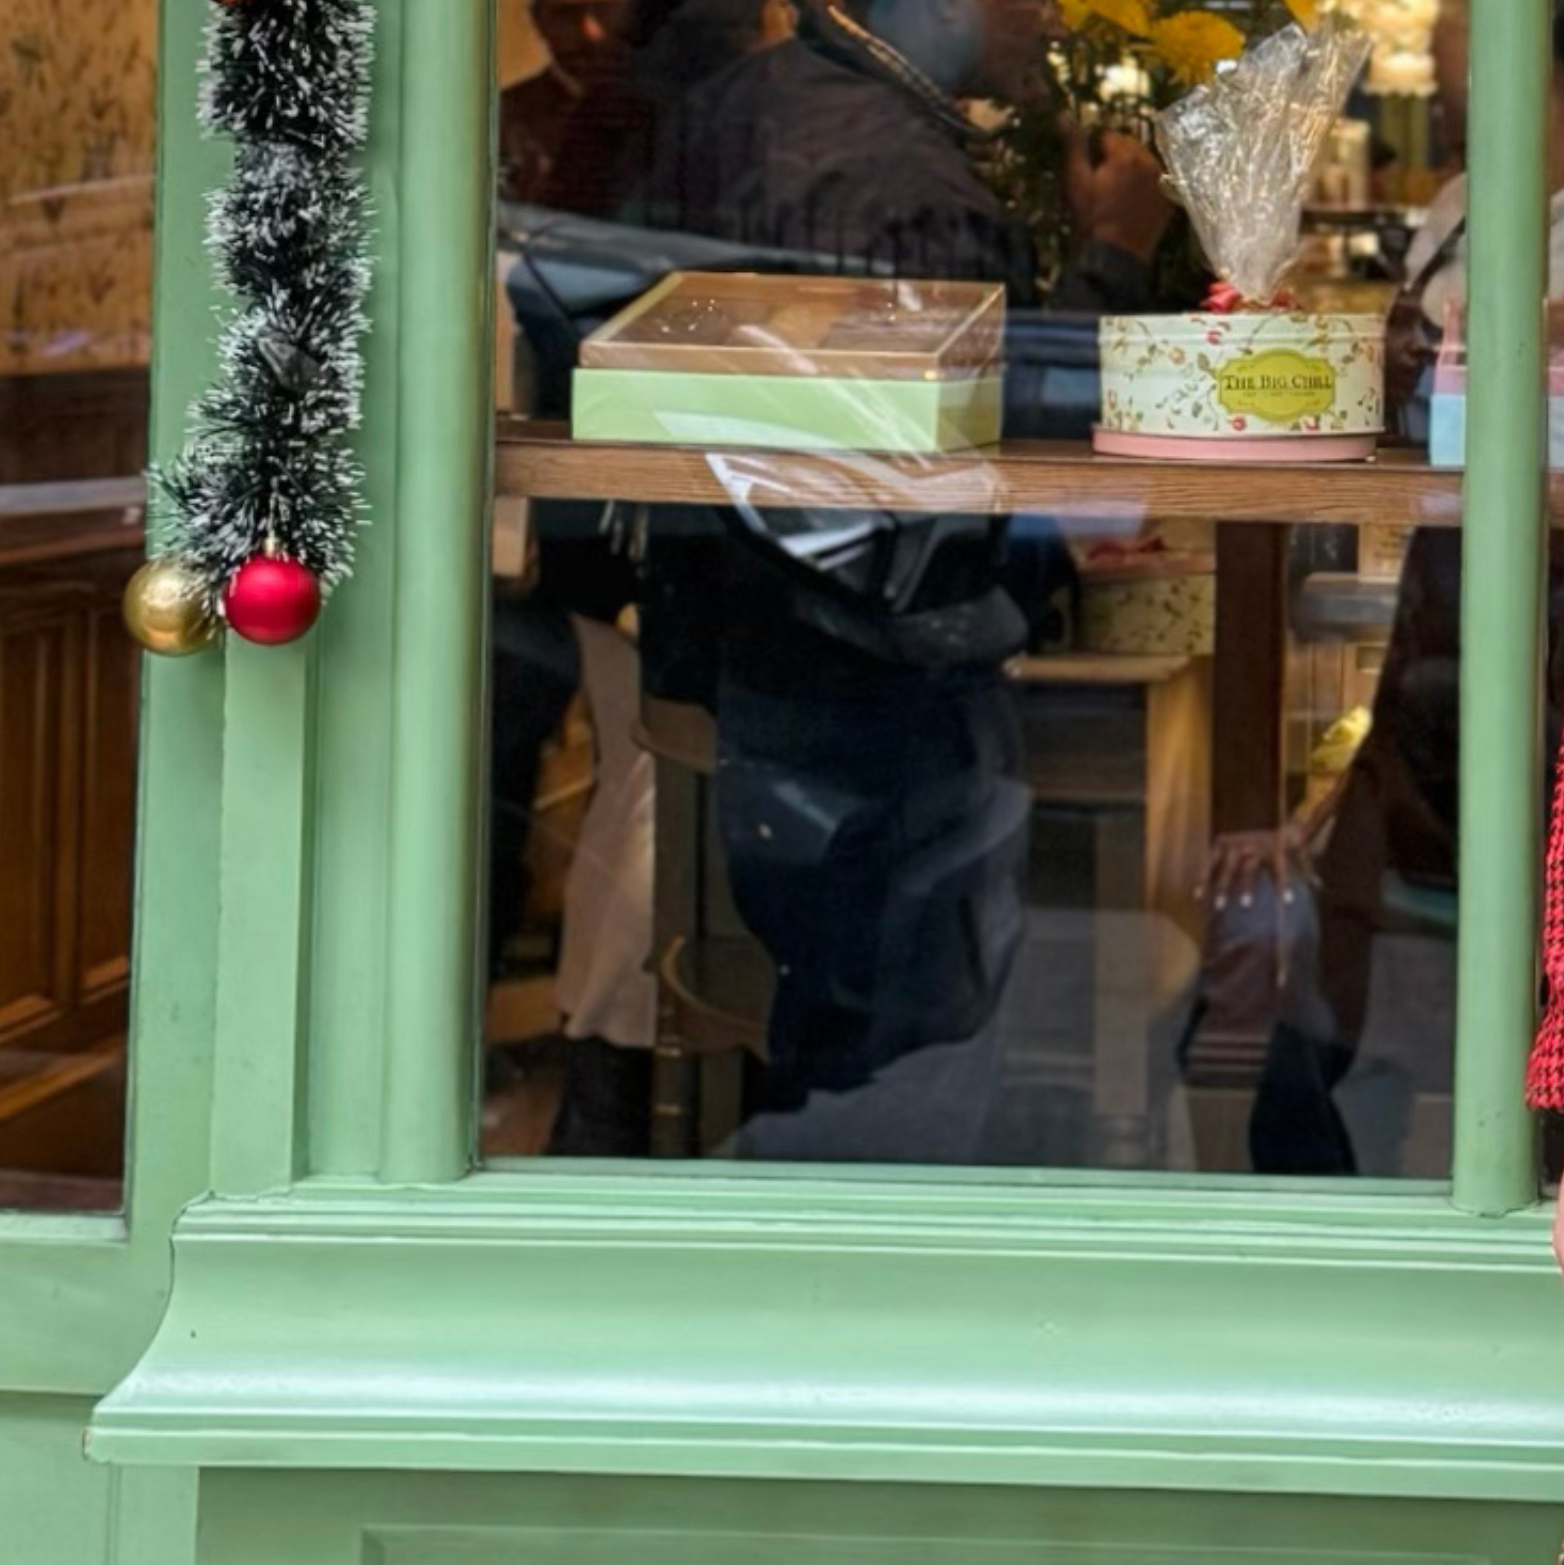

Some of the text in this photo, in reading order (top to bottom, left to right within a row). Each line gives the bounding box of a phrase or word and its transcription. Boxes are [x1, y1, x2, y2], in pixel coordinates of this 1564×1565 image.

[1223, 373, 1332, 390] THE BIG CHILL
